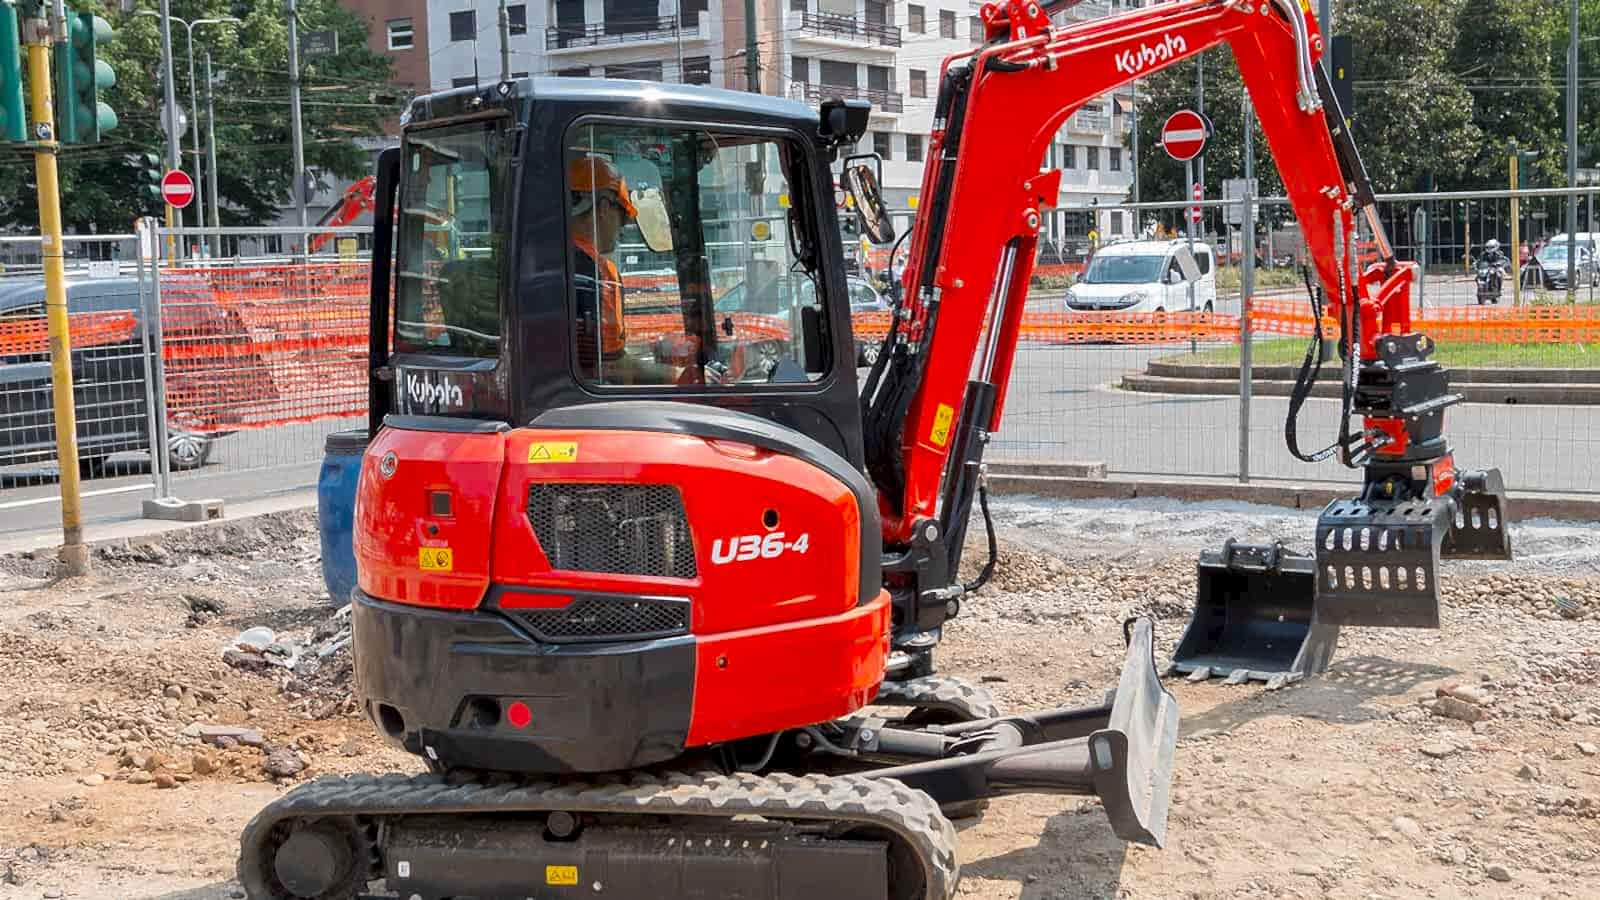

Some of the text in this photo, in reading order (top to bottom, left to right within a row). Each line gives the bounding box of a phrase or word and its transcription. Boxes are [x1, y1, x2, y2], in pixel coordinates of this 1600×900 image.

[1115, 33, 1186, 74] Kubota
[407, 374, 463, 407] Kubota
[711, 532, 809, 564] U36-4
